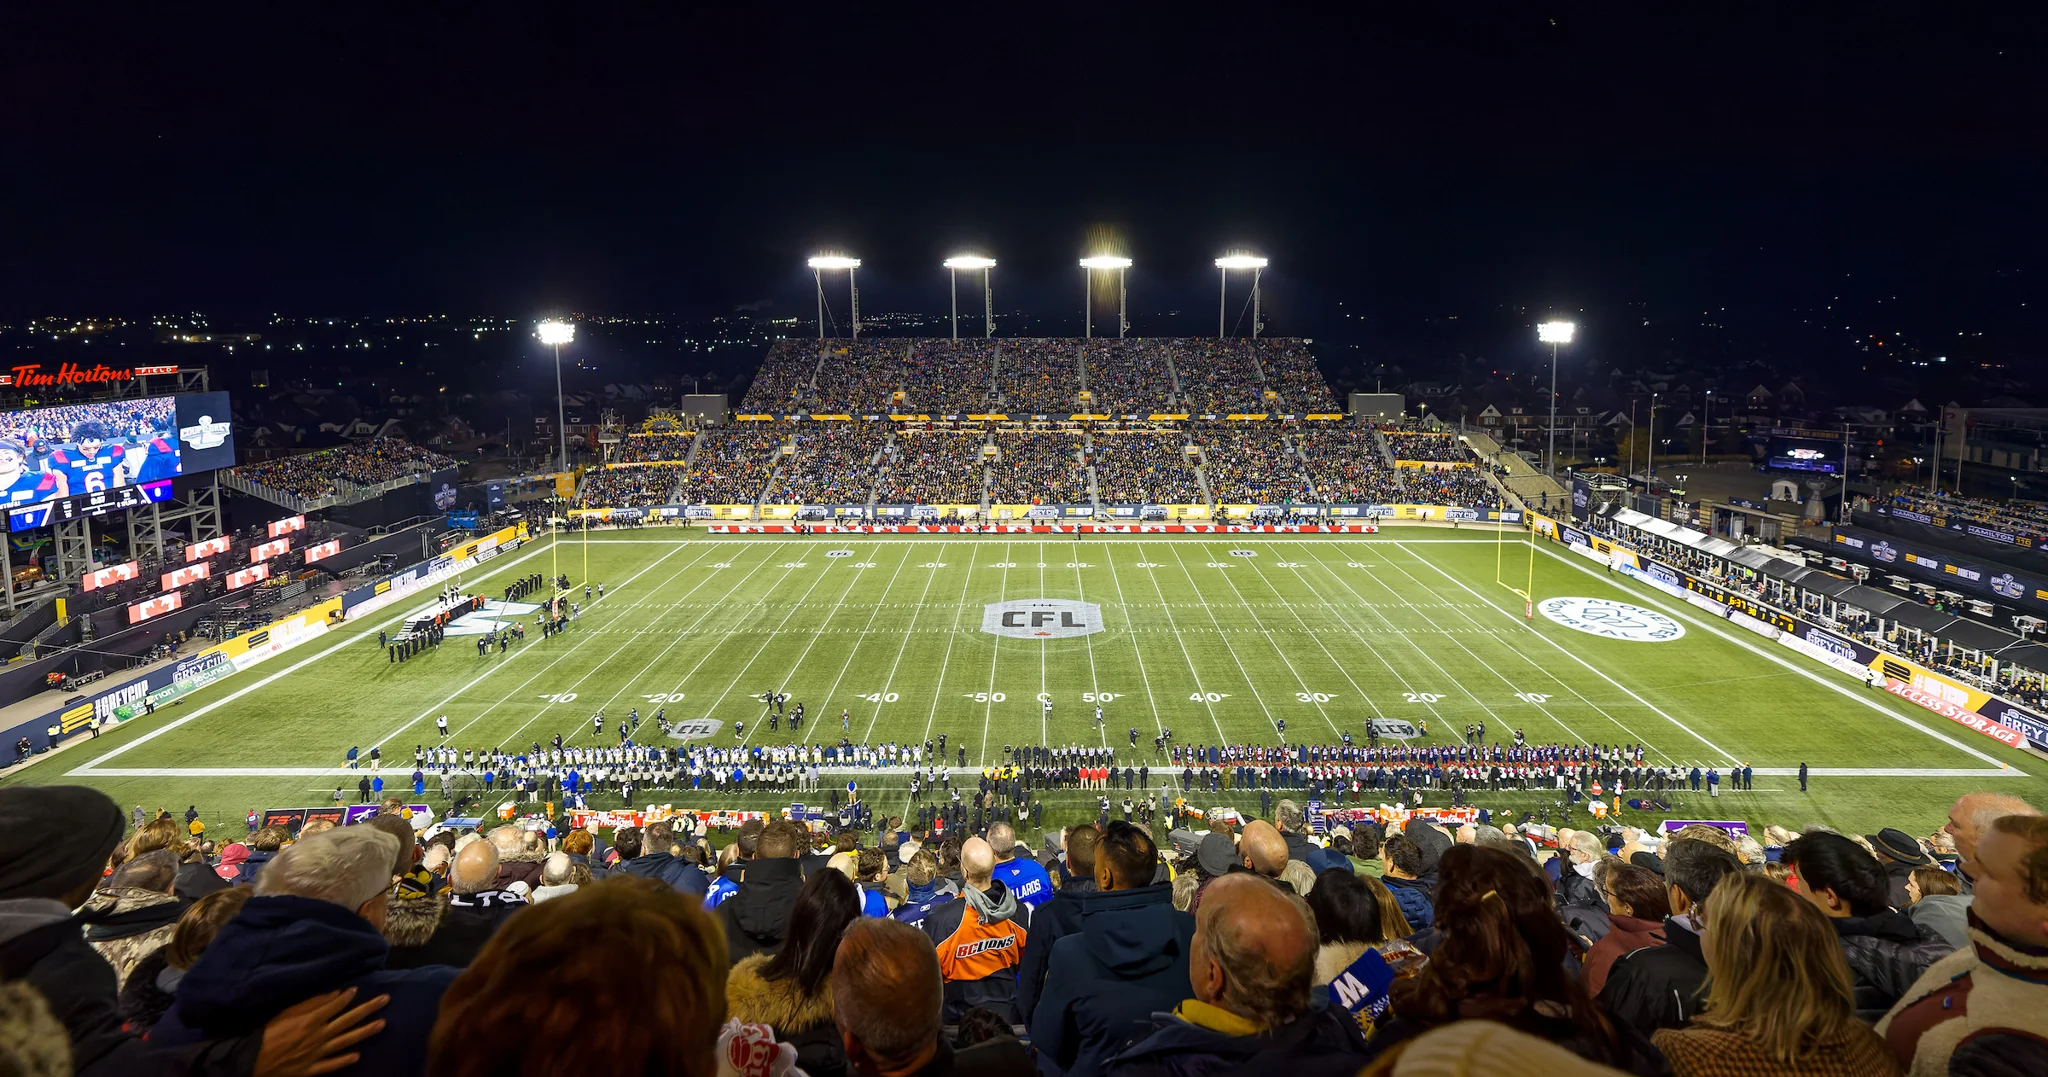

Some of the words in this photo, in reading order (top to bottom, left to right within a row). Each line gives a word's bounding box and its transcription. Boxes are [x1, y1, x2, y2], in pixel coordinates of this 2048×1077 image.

[12, 364, 54, 388] Tim
[57, 362, 132, 385] Hortons
[84, 471, 106, 493] 6
[1893, 509, 1931, 523] HAMILTON
[1968, 526, 2014, 543] HAMILTON
[2016, 536, 2032, 547] 110
[420, 558, 474, 587] BELGARD
[1002, 612, 1086, 628] CFL
[1547, 599, 1639, 639] MONTREAL
[1730, 596, 1747, 610] 6:37
[1788, 623, 1794, 632] 0
[1807, 631, 1833, 651] GREY
[1834, 645, 1857, 661] CUP
[174, 662, 205, 682] GREY
[206, 653, 228, 669] CUP
[193, 663, 231, 684] securian
[95, 679, 149, 720] #GREYCUP
[548, 692, 578, 703] 10
[650, 692, 686, 703] 20
[865, 692, 900, 703] 40
[975, 692, 1007, 703] 50
[1082, 692, 1114, 703] 50
[1189, 692, 1223, 703] 40
[1295, 692, 1330, 703] 30
[1402, 692, 1438, 703] 20
[1514, 692, 1547, 703] 10
[1889, 682, 1945, 711] ACCESS
[1943, 705, 2018, 744] STORAGE
[676, 725, 712, 735] CFL
[2002, 712, 2044, 740] GREY
[601, 813, 636, 828] Hortons
